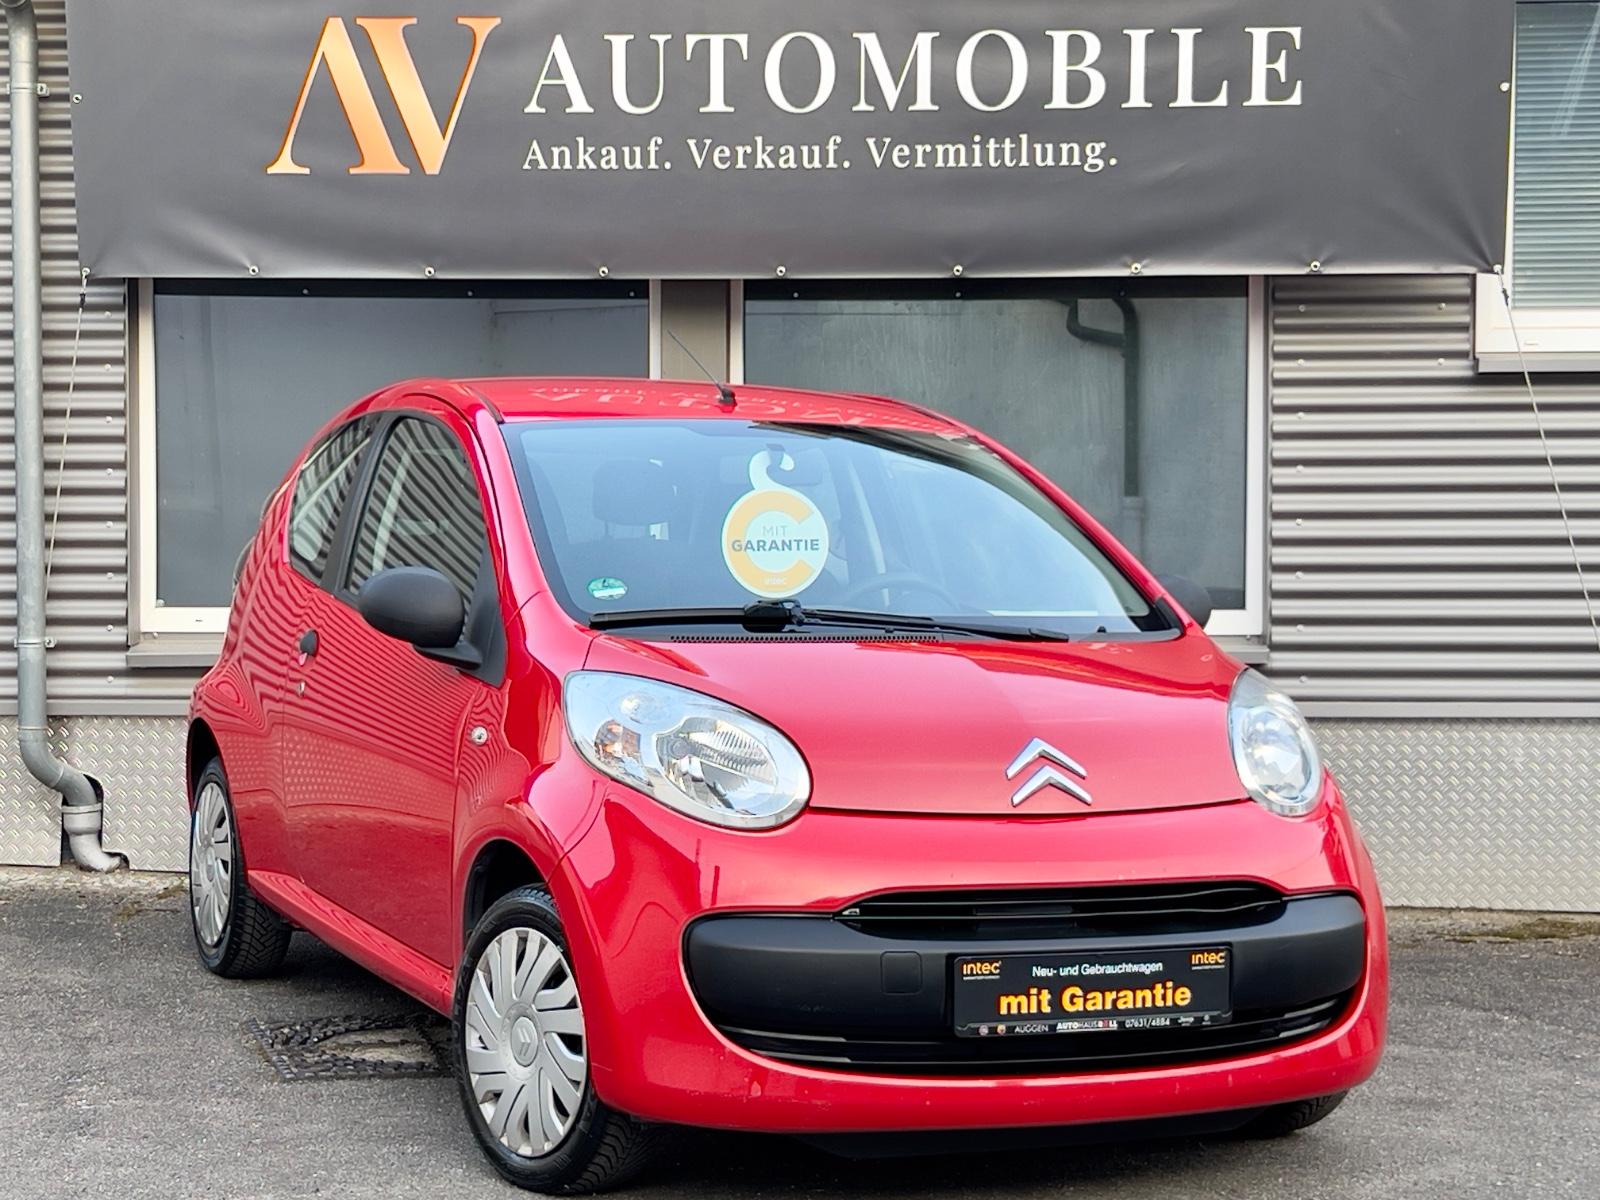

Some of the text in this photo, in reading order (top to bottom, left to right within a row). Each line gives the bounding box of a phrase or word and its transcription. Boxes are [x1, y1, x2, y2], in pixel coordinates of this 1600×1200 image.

[523, 26, 1304, 115] AUTOMOBILE
[522, 133, 1119, 173] Ankauf. Verkauf. Vermittlung.
[762, 525, 788, 537] MIT
[731, 538, 820, 552] GARANTIE
[1191, 952, 1225, 964] intec
[963, 962, 1001, 975] intec
[1032, 962, 1163, 977] Neu- und Gebrauchtwagen
[999, 981, 1192, 1015] mit Garantie
[1014, 1024, 1049, 1034] AUGGEN
